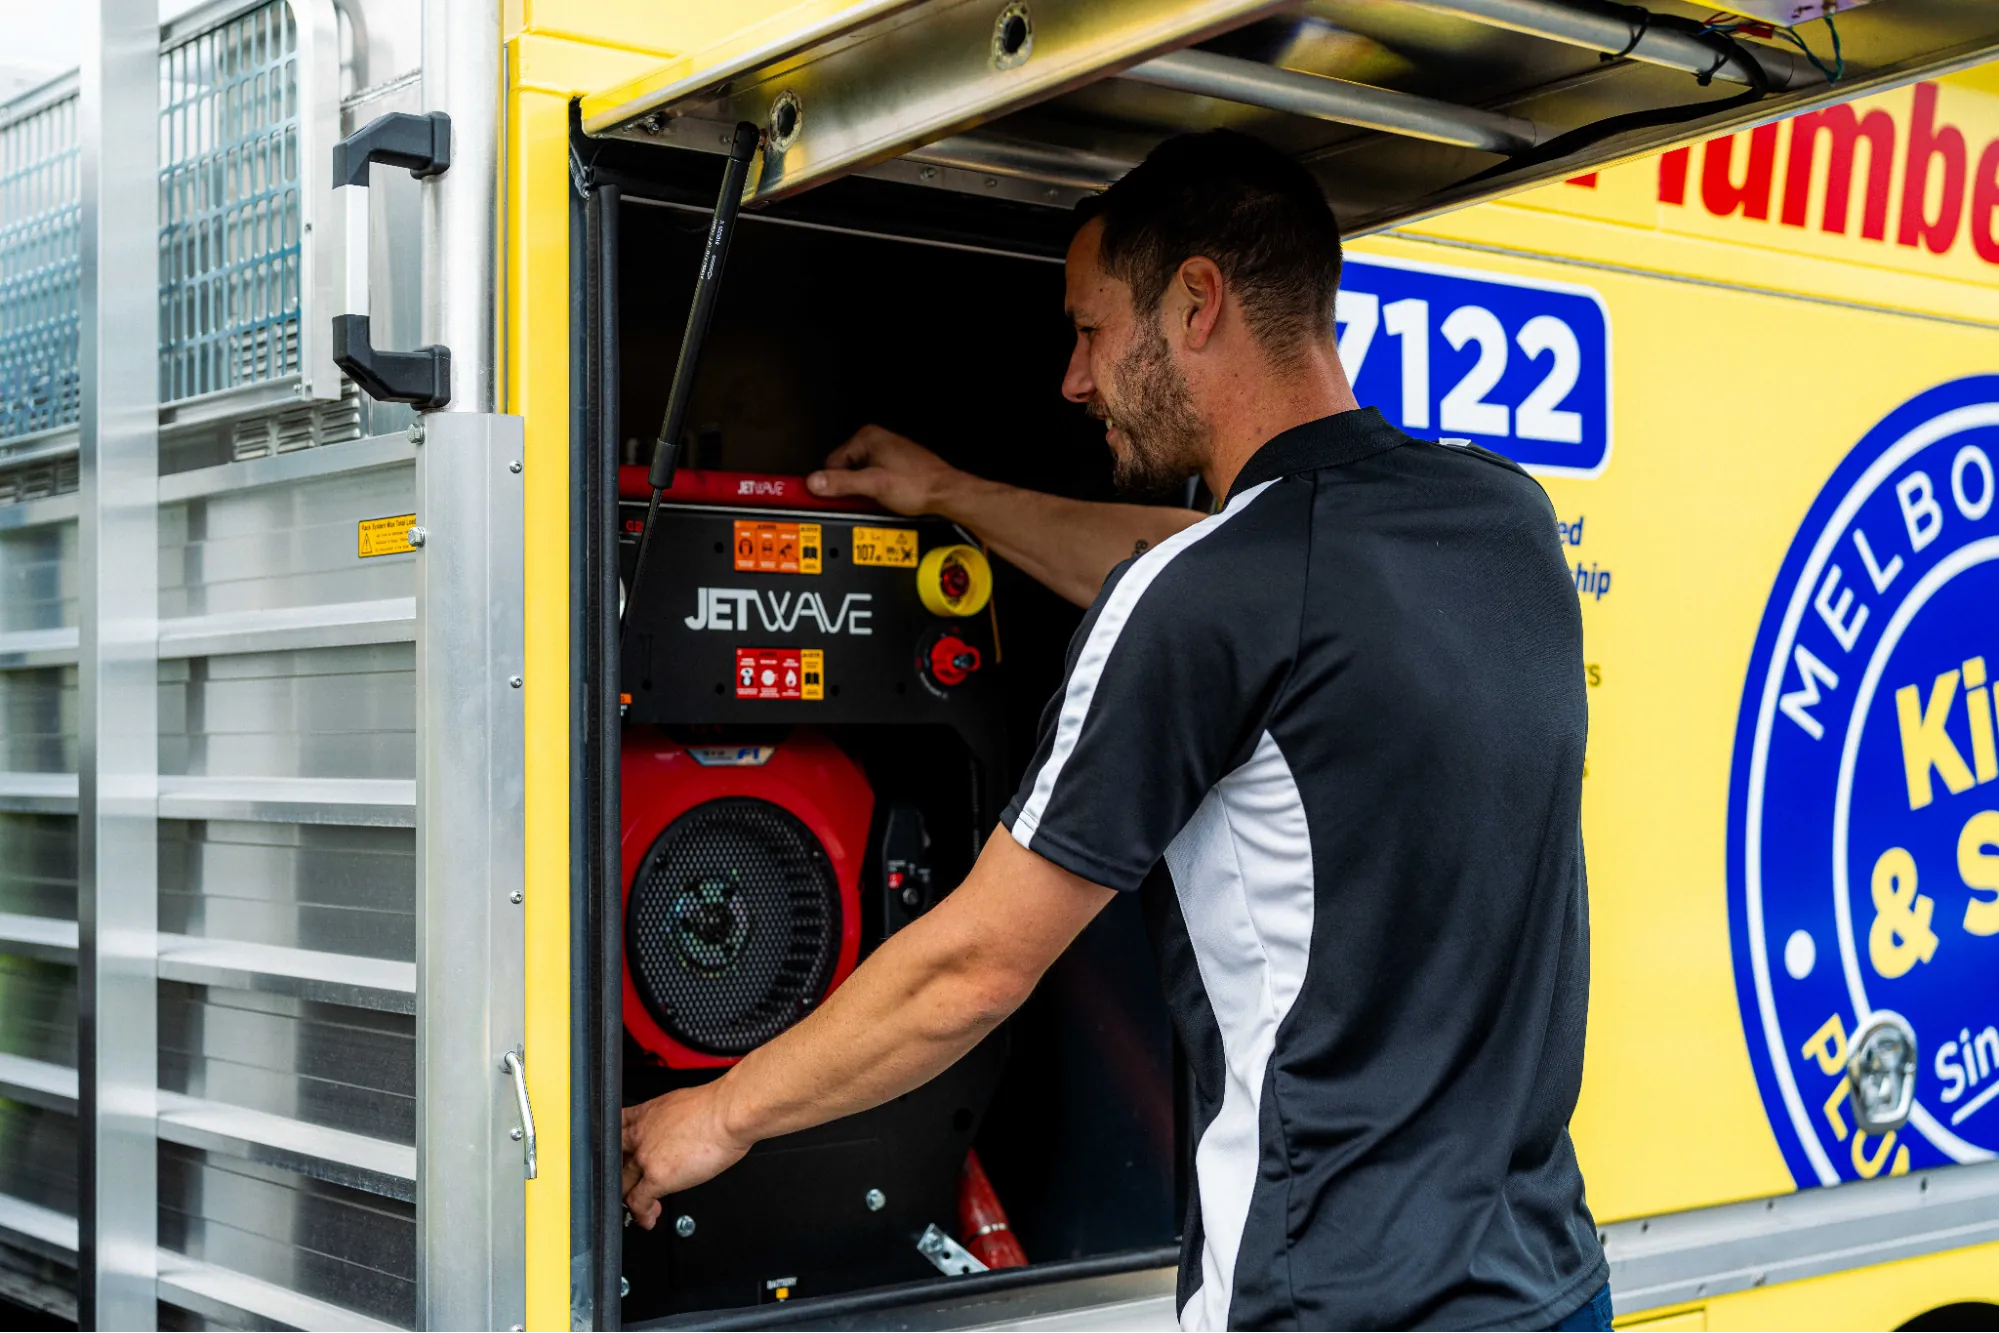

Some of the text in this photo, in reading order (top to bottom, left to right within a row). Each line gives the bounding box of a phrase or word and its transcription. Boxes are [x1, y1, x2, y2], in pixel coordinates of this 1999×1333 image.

[1336, 288, 1583, 444] 7122
[737, 480, 785, 496] JETWAVE
[684, 587, 872, 635] JETWAVE
[1569, 562, 1611, 601] hip
[1779, 444, 1997, 741] MELBO
[1895, 655, 1999, 811] Ki
[1868, 846, 1940, 980] &
